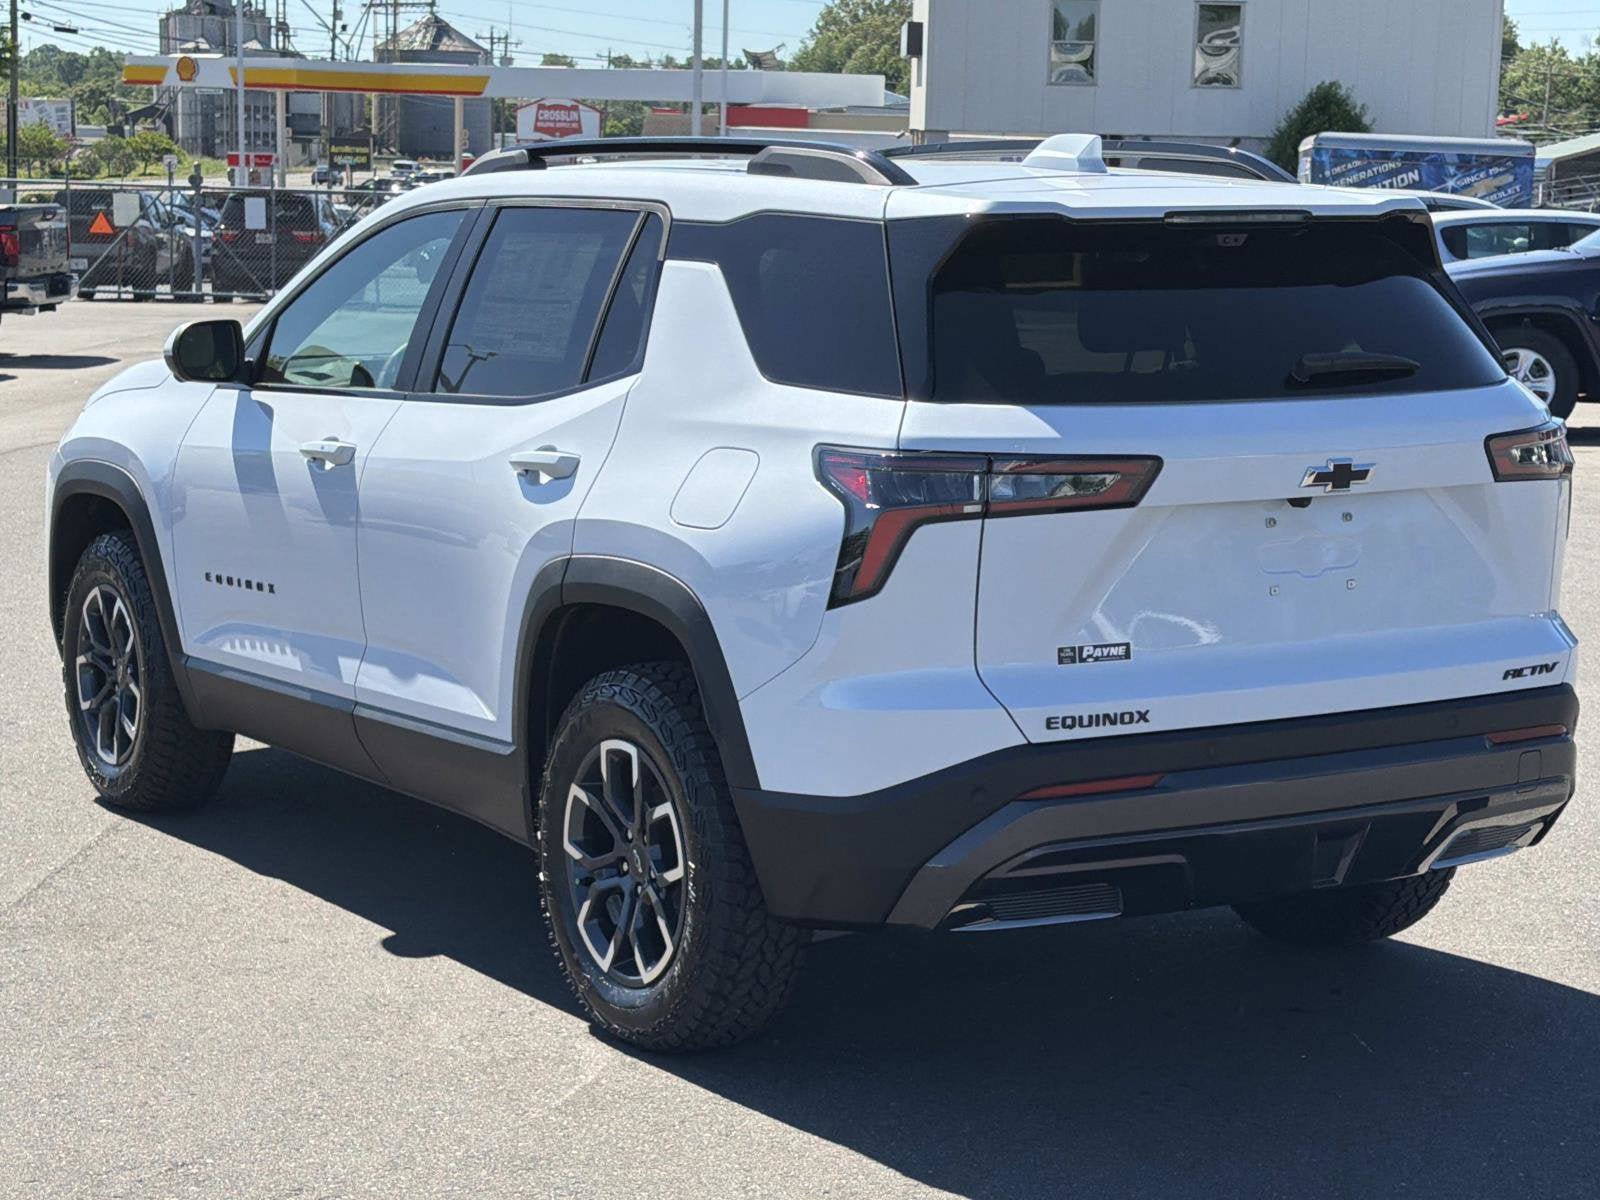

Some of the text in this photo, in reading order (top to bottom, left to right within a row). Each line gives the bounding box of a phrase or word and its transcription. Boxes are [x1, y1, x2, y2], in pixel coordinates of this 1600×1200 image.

[538, 109, 579, 121] CROSSLIN
[1456, 171, 1488, 186] SINCE
[205, 572, 275, 594] EQUINOX
[1082, 646, 1127, 658] PAYNE
[1502, 661, 1561, 680] ACTIV
[1046, 709, 1150, 730] EQUINOX
